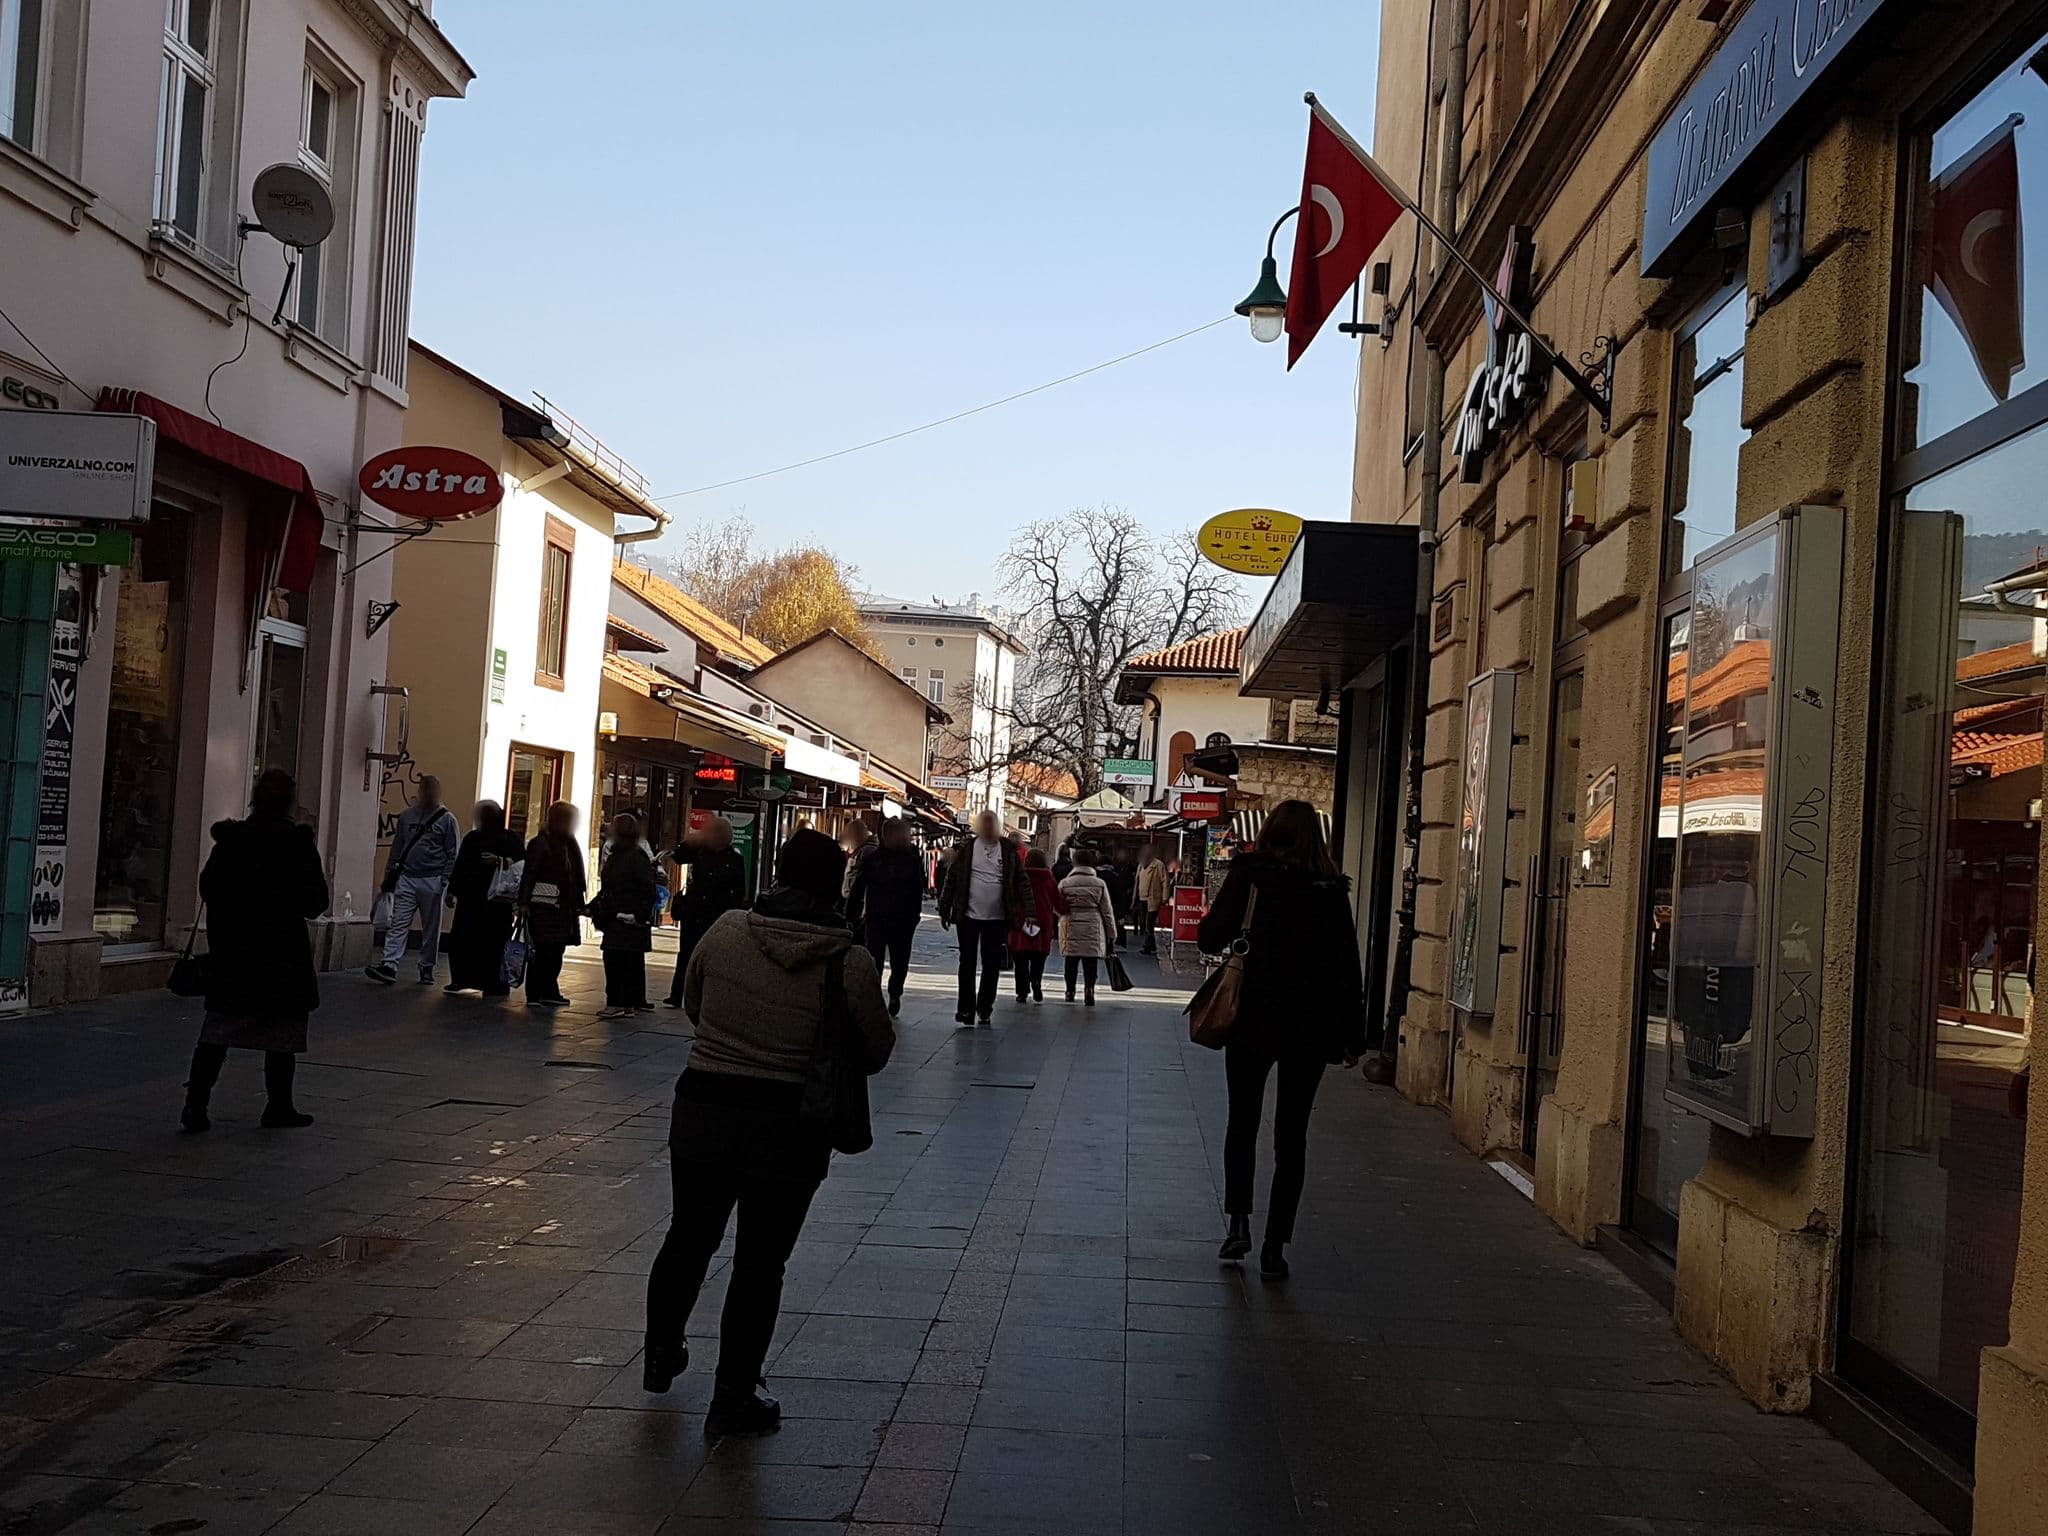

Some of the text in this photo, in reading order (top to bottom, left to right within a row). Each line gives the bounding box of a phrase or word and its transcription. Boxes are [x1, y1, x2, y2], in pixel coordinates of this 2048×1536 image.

[1670, 16, 1779, 226] ZLATARNA
[9, 455, 135, 473] UNIVERZALNO.COM
[71, 471, 134, 482] ONLINE SHOP
[372, 464, 487, 494] Astra
[1214, 529, 1257, 542] HOTEL
[33, 547, 72, 560] Phone
[1220, 553, 1267, 564] HOTEL
[51, 658, 77, 672] SERVIS
